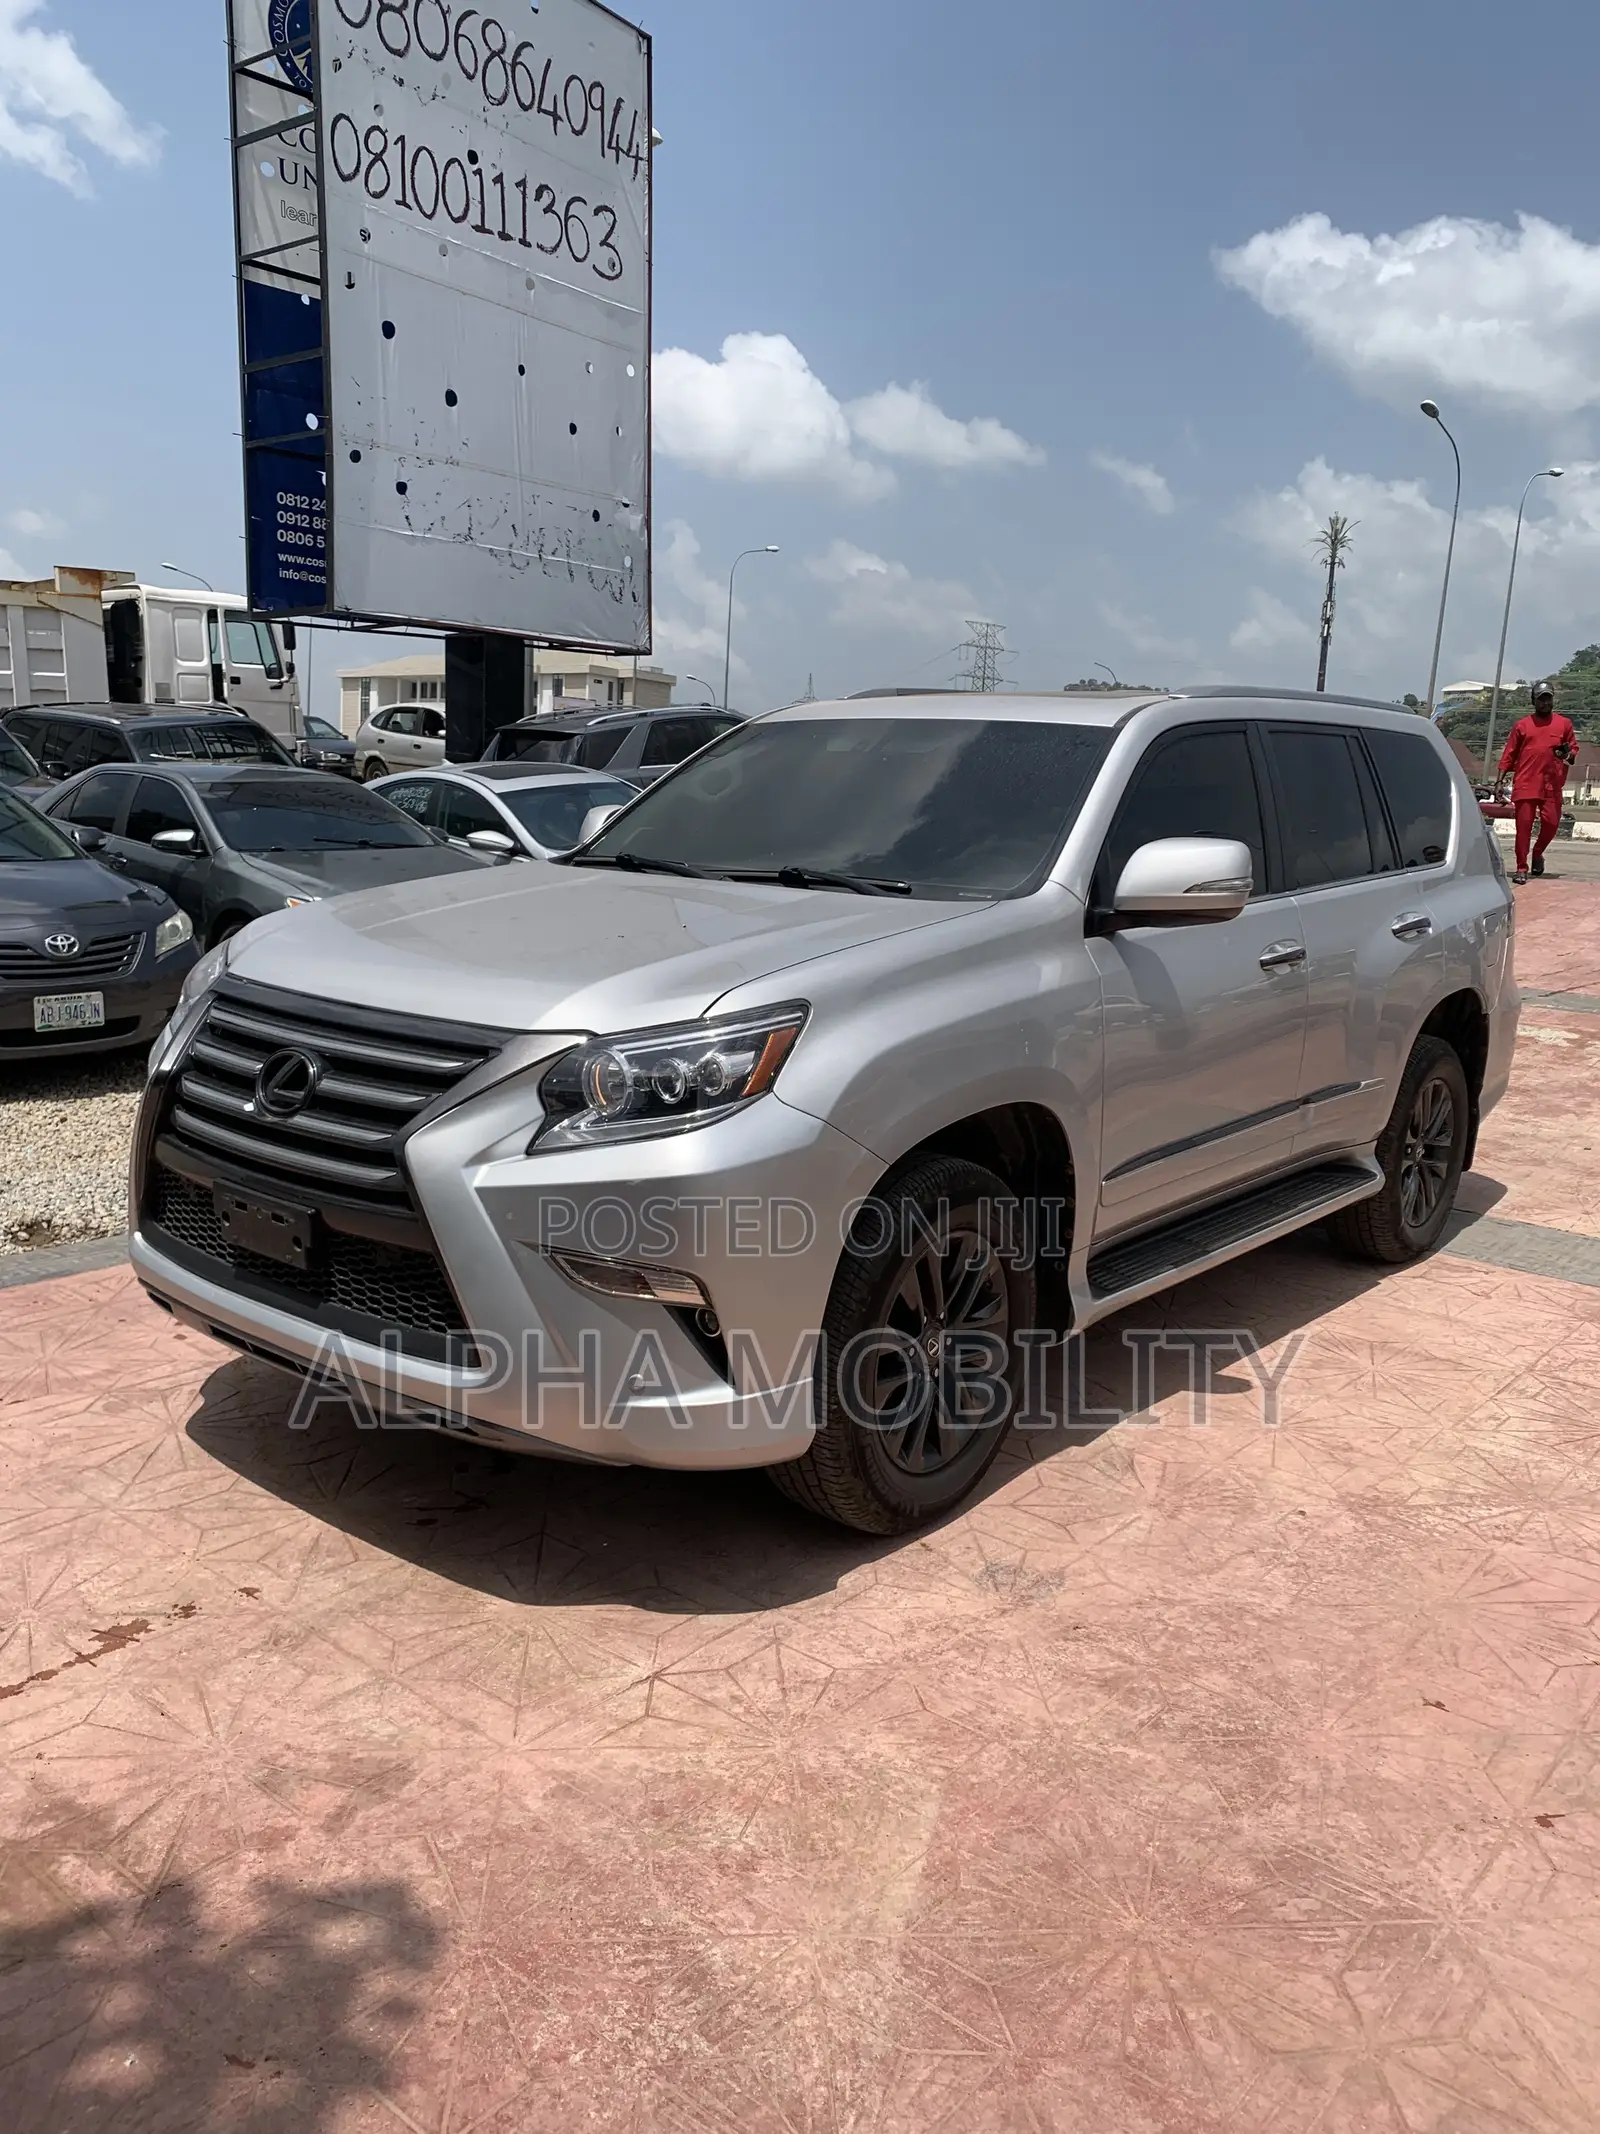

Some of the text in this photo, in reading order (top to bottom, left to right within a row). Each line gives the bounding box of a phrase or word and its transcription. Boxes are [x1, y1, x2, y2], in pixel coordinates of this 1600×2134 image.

[330, 113, 623, 281] 08100111363
[276, 491, 310, 509] 0812
[276, 510, 310, 528] 0912
[276, 529, 314, 547] 0806
[277, 553, 327, 568] www.cos
